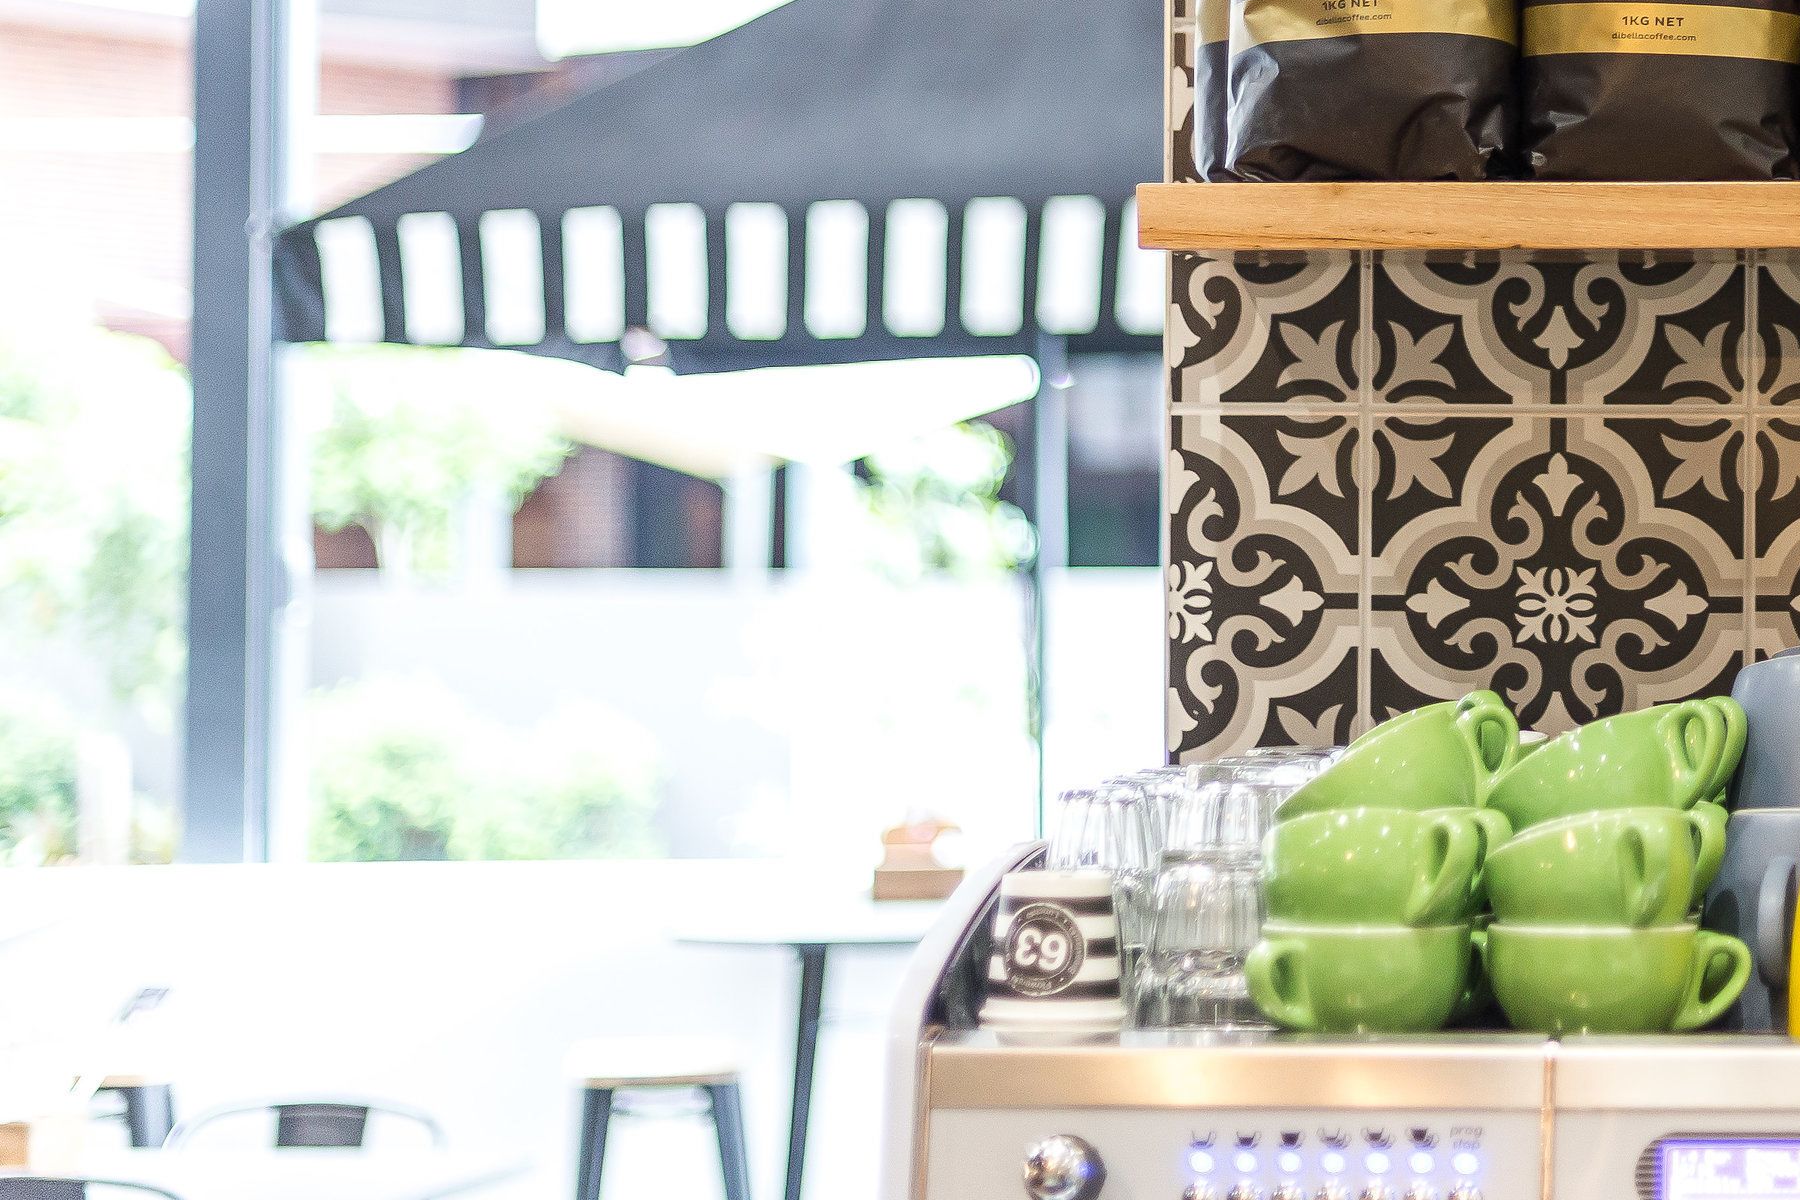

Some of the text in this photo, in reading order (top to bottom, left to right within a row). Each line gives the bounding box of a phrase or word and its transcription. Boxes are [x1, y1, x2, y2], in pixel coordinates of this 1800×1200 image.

[1322, 0, 1346, 11] 1KG
[1622, 16, 1684, 27] 1KG NET
[1612, 32, 1696, 42] dibellacoffee.com
[1015, 927, 1069, 971] 63
